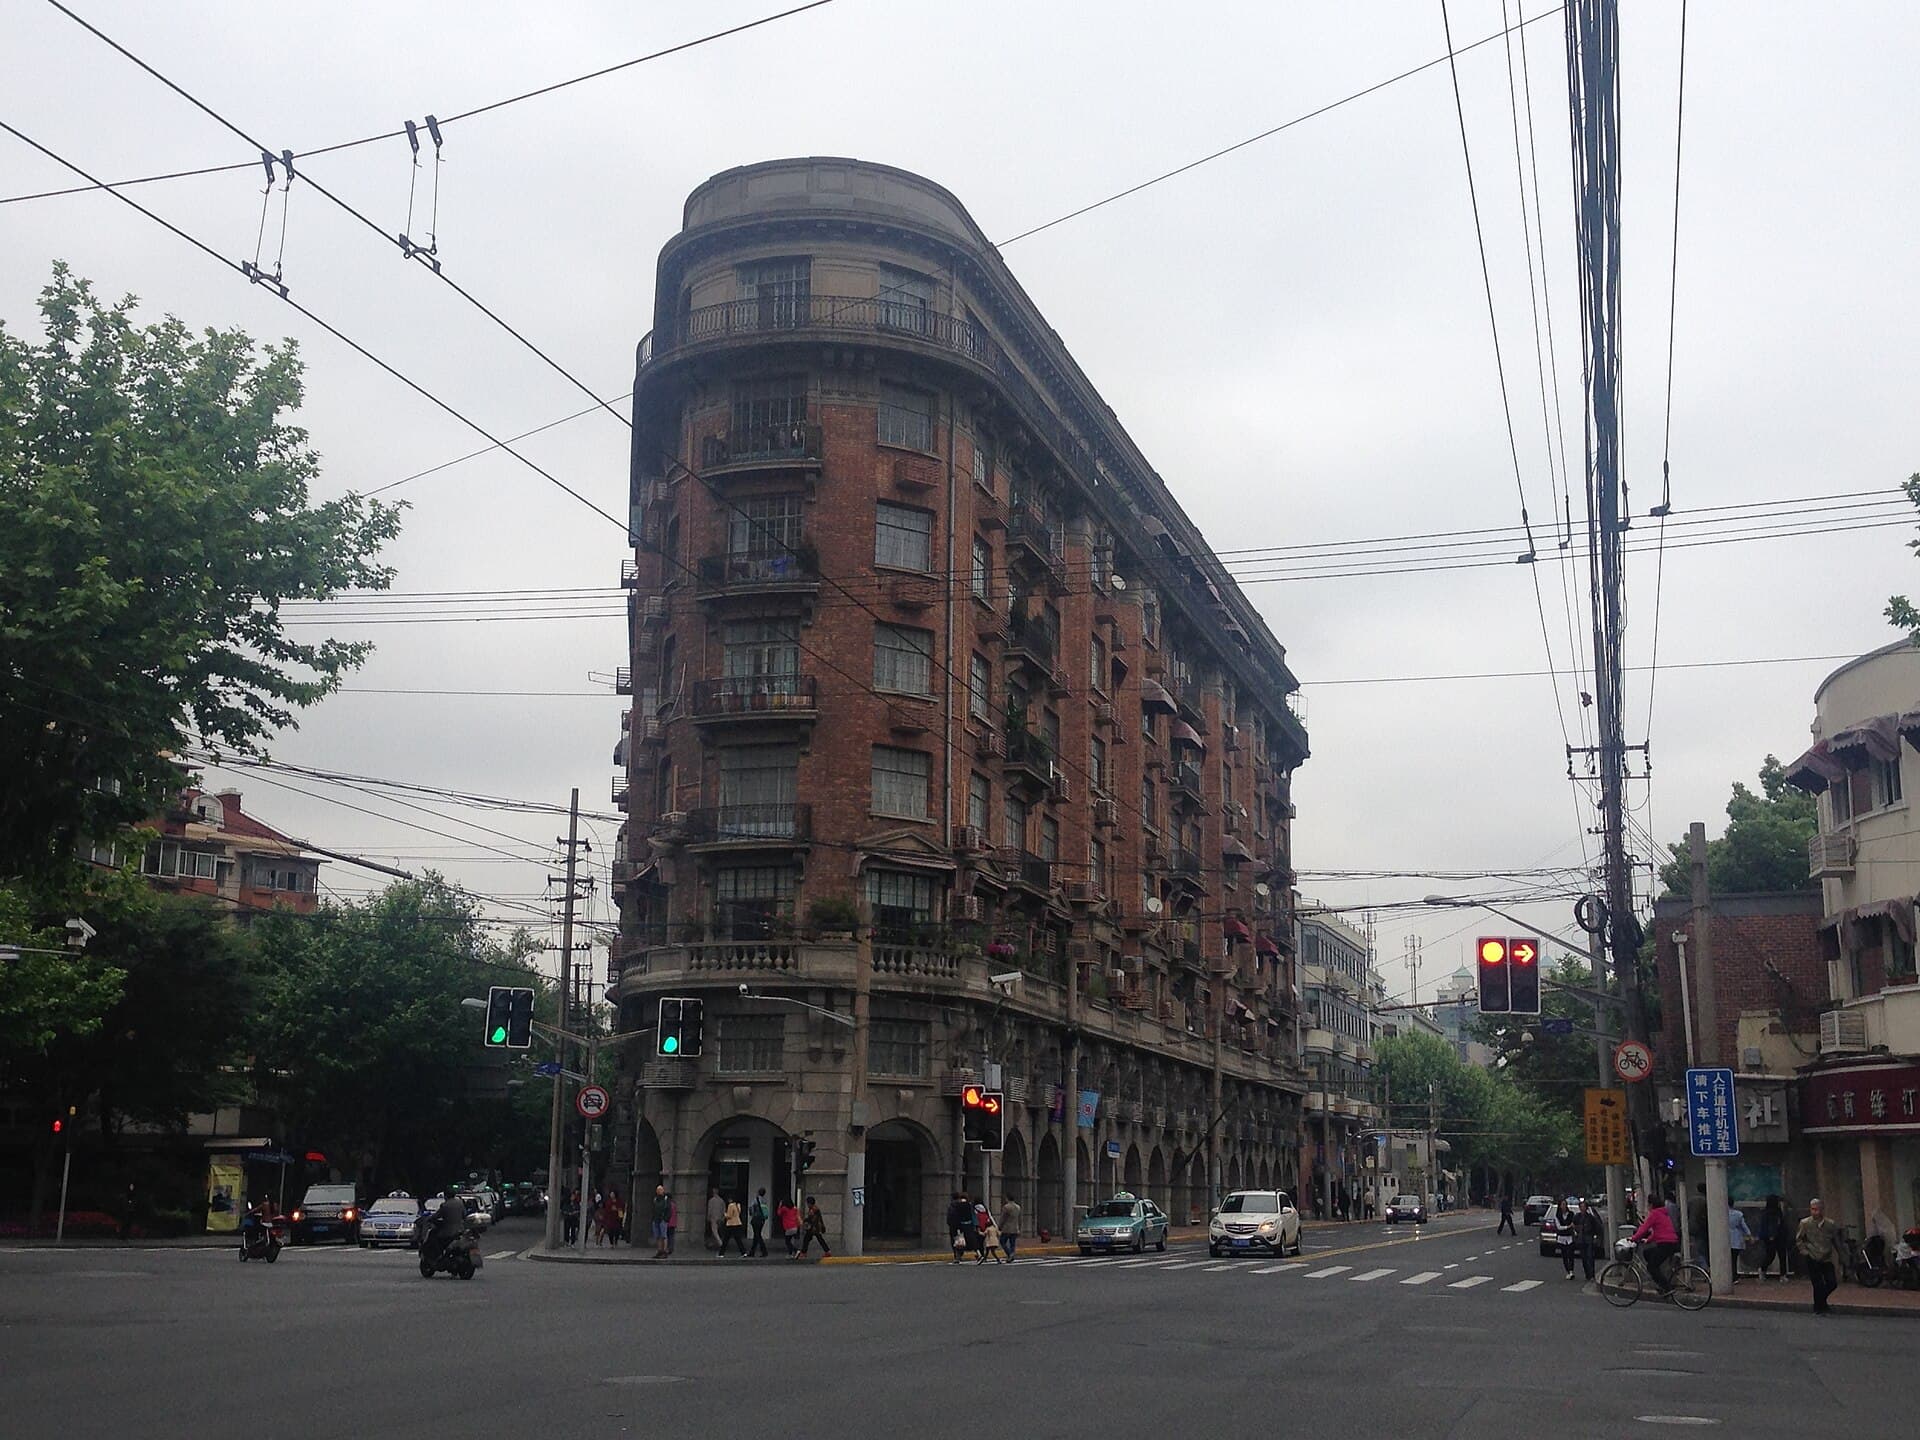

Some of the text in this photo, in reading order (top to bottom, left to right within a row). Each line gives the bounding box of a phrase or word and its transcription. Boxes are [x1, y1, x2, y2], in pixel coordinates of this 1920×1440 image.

[1694, 1074, 1713, 1151] 请下车推行
[1712, 1072, 1731, 1152] 人行道非机动车
